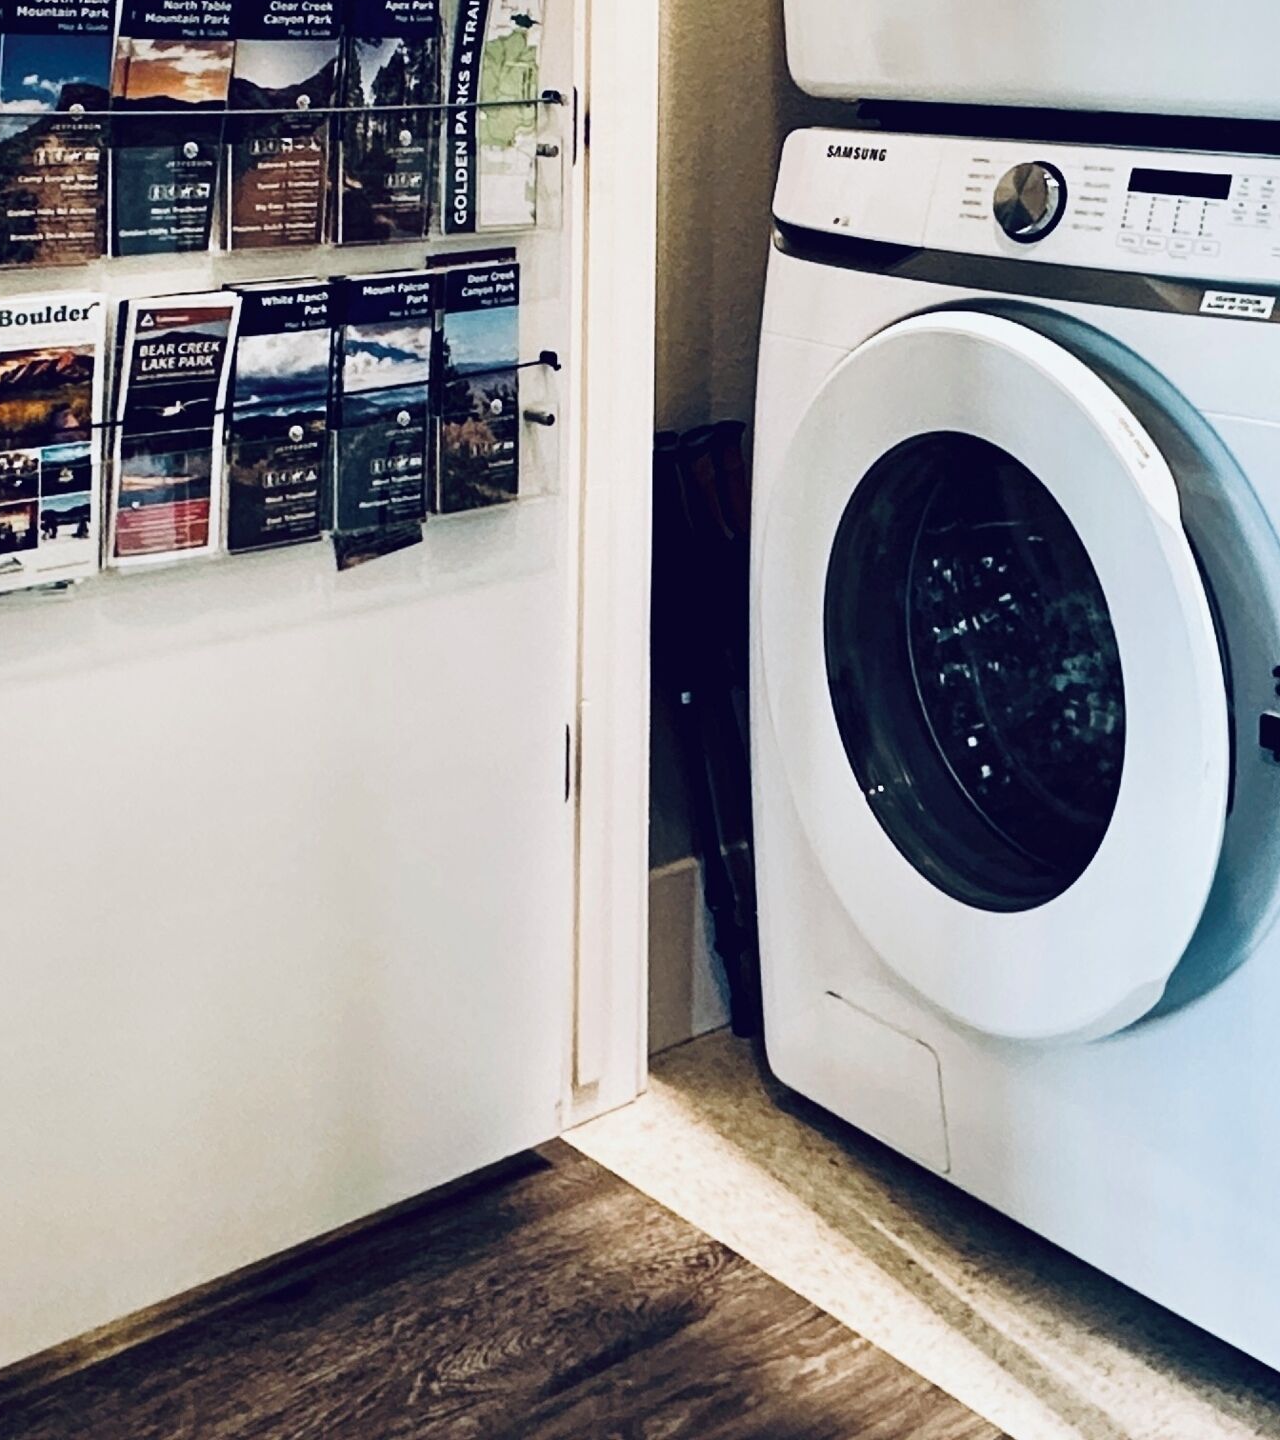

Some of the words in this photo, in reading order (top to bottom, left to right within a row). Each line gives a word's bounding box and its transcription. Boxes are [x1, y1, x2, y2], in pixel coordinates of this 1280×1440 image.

[164, 0, 197, 11] North
[270, 0, 298, 11] Clear
[16, 6, 77, 17] Mountain
[81, 7, 109, 18] Park
[145, 13, 199, 24] Mountain
[204, 14, 230, 25] Park
[264, 14, 304, 26] Canyon
[307, 14, 332, 25] Park
[461, 51, 473, 64] &
[455, 71, 471, 135] PARKS
[827, 145, 887, 161] SAMSUNG
[454, 141, 469, 225] GOLDEN
[406, 294, 428, 304] Park
[304, 304, 327, 315] Park
[139, 343, 175, 357] BEAR
[178, 341, 220, 354] CREEK
[141, 357, 176, 371] LAKE
[178, 354, 215, 368] PARK
